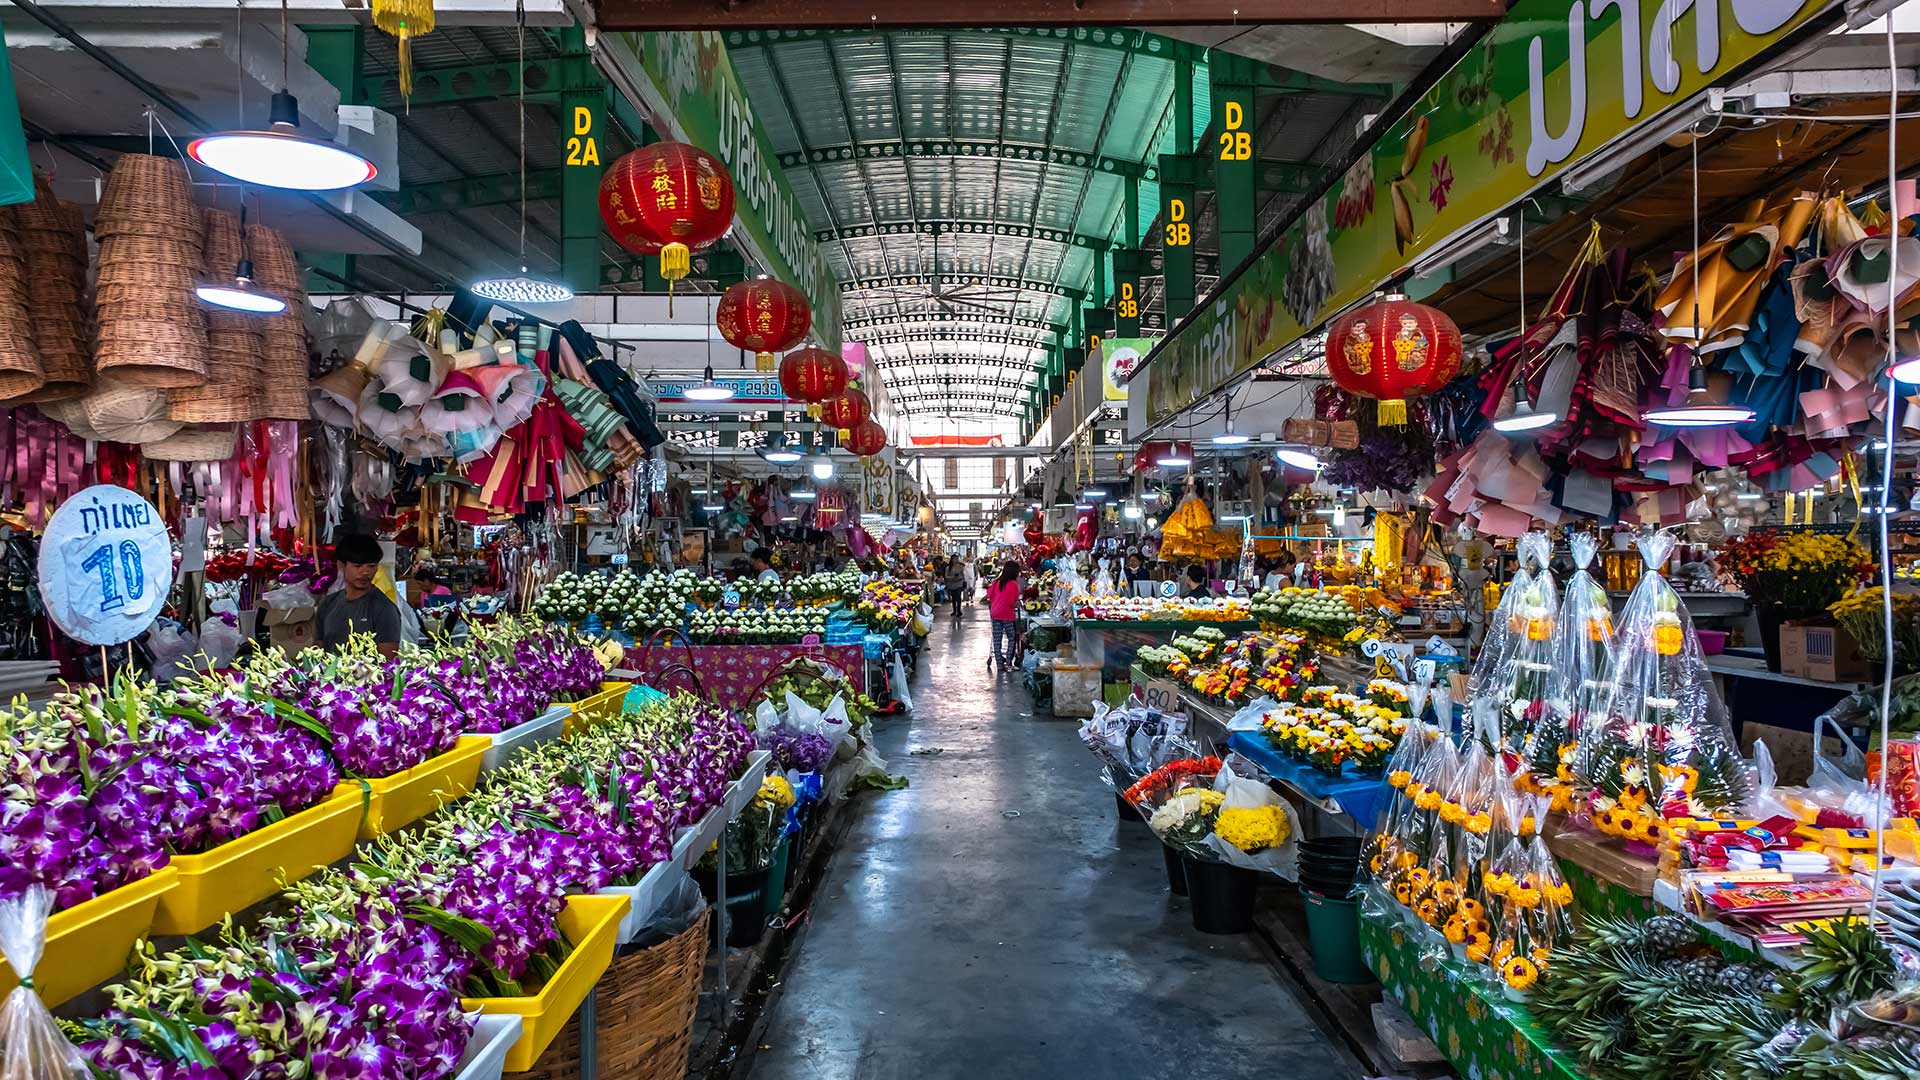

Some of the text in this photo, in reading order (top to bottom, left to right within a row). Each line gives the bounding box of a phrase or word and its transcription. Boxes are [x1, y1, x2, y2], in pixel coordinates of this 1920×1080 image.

[574, 106, 592, 135] D
[1226, 101, 1243, 130] D
[566, 137, 600, 166] 2A
[1220, 131, 1252, 161] 2B
[1171, 199, 1185, 222] D
[1166, 223, 1191, 246] 3B
[1122, 282, 1133, 300] D
[1118, 300, 1138, 318] 3B
[1192, 300, 1237, 398] มาลัย
[81, 539, 144, 612] 10
[1146, 687, 1170, 709] 80
